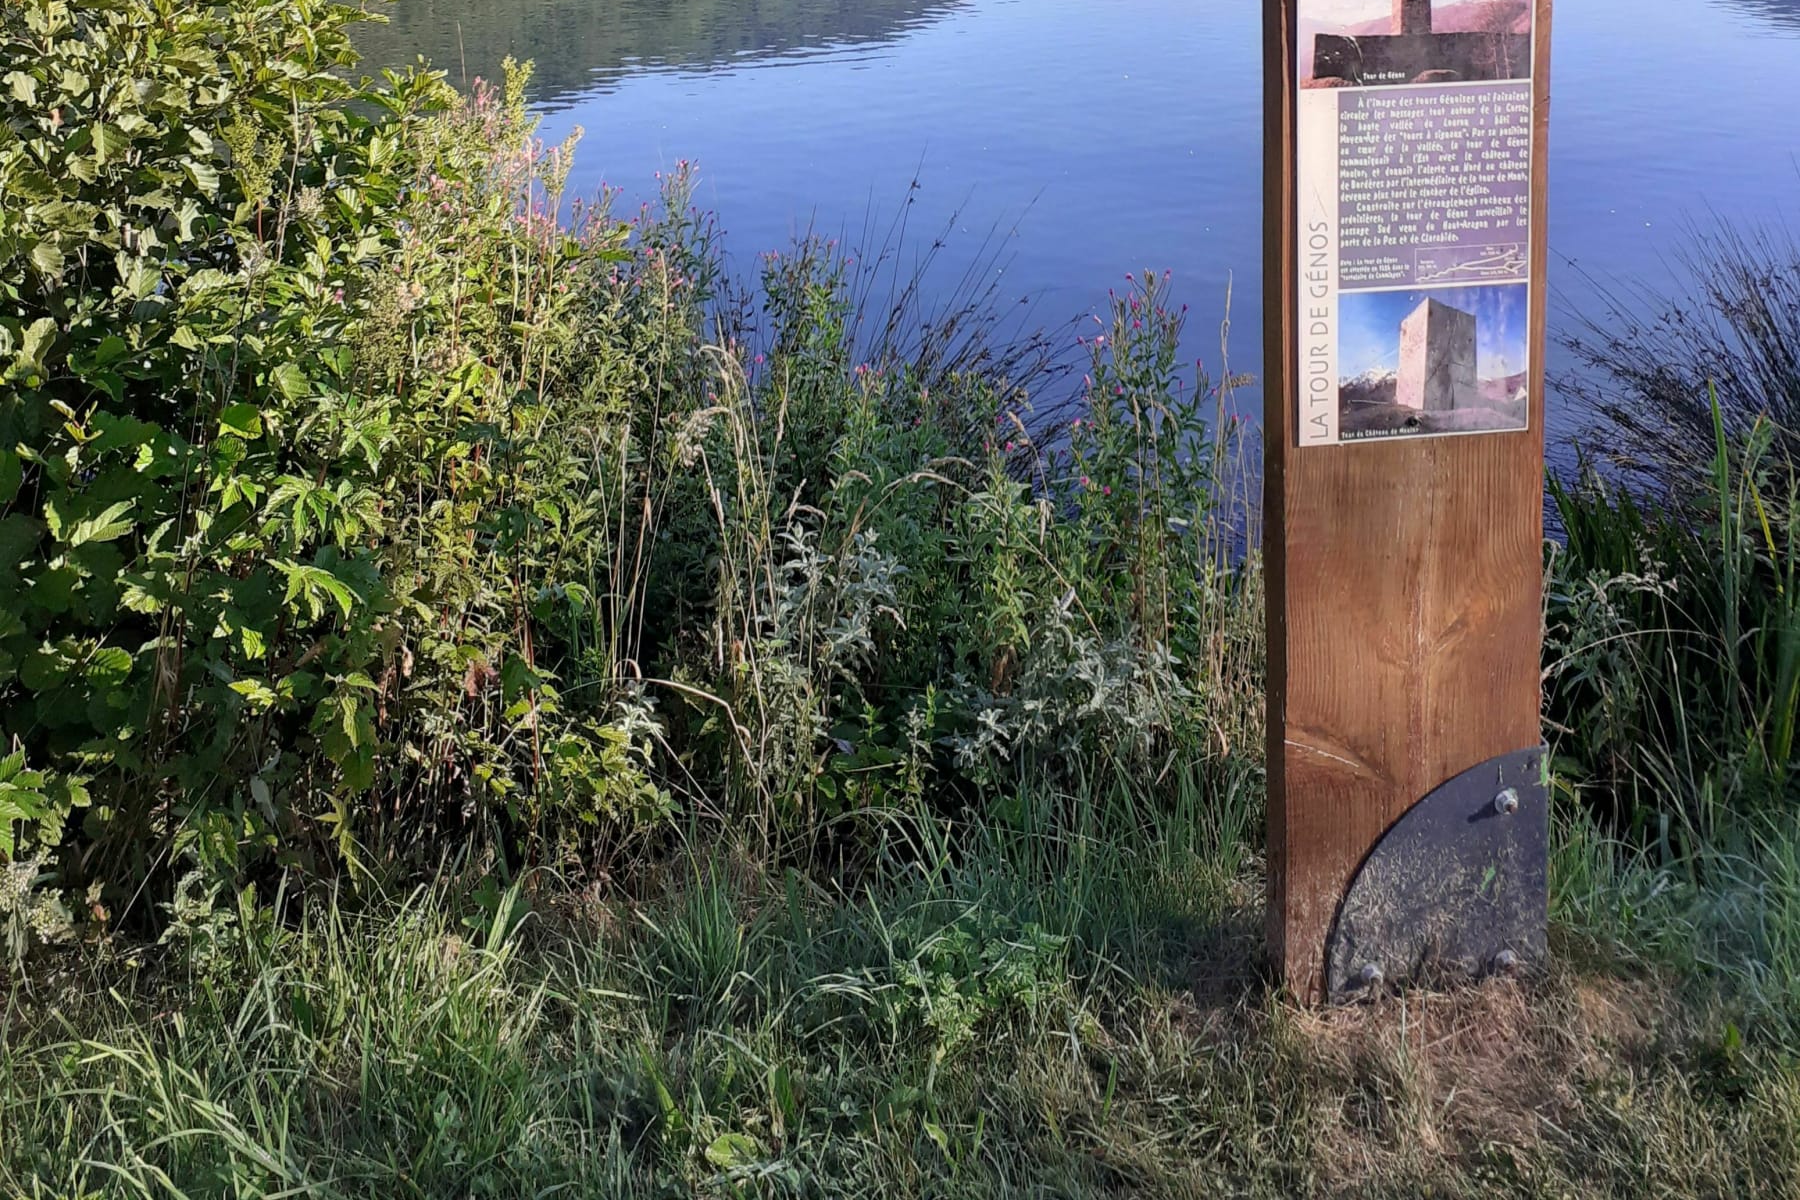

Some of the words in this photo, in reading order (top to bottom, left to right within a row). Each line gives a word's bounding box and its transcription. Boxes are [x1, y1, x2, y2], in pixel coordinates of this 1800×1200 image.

[1305, 221, 1328, 298] GÉNOS
[1310, 307, 1328, 336] DE
[1310, 343, 1328, 408] TOUR
[1310, 412, 1328, 439] LA
